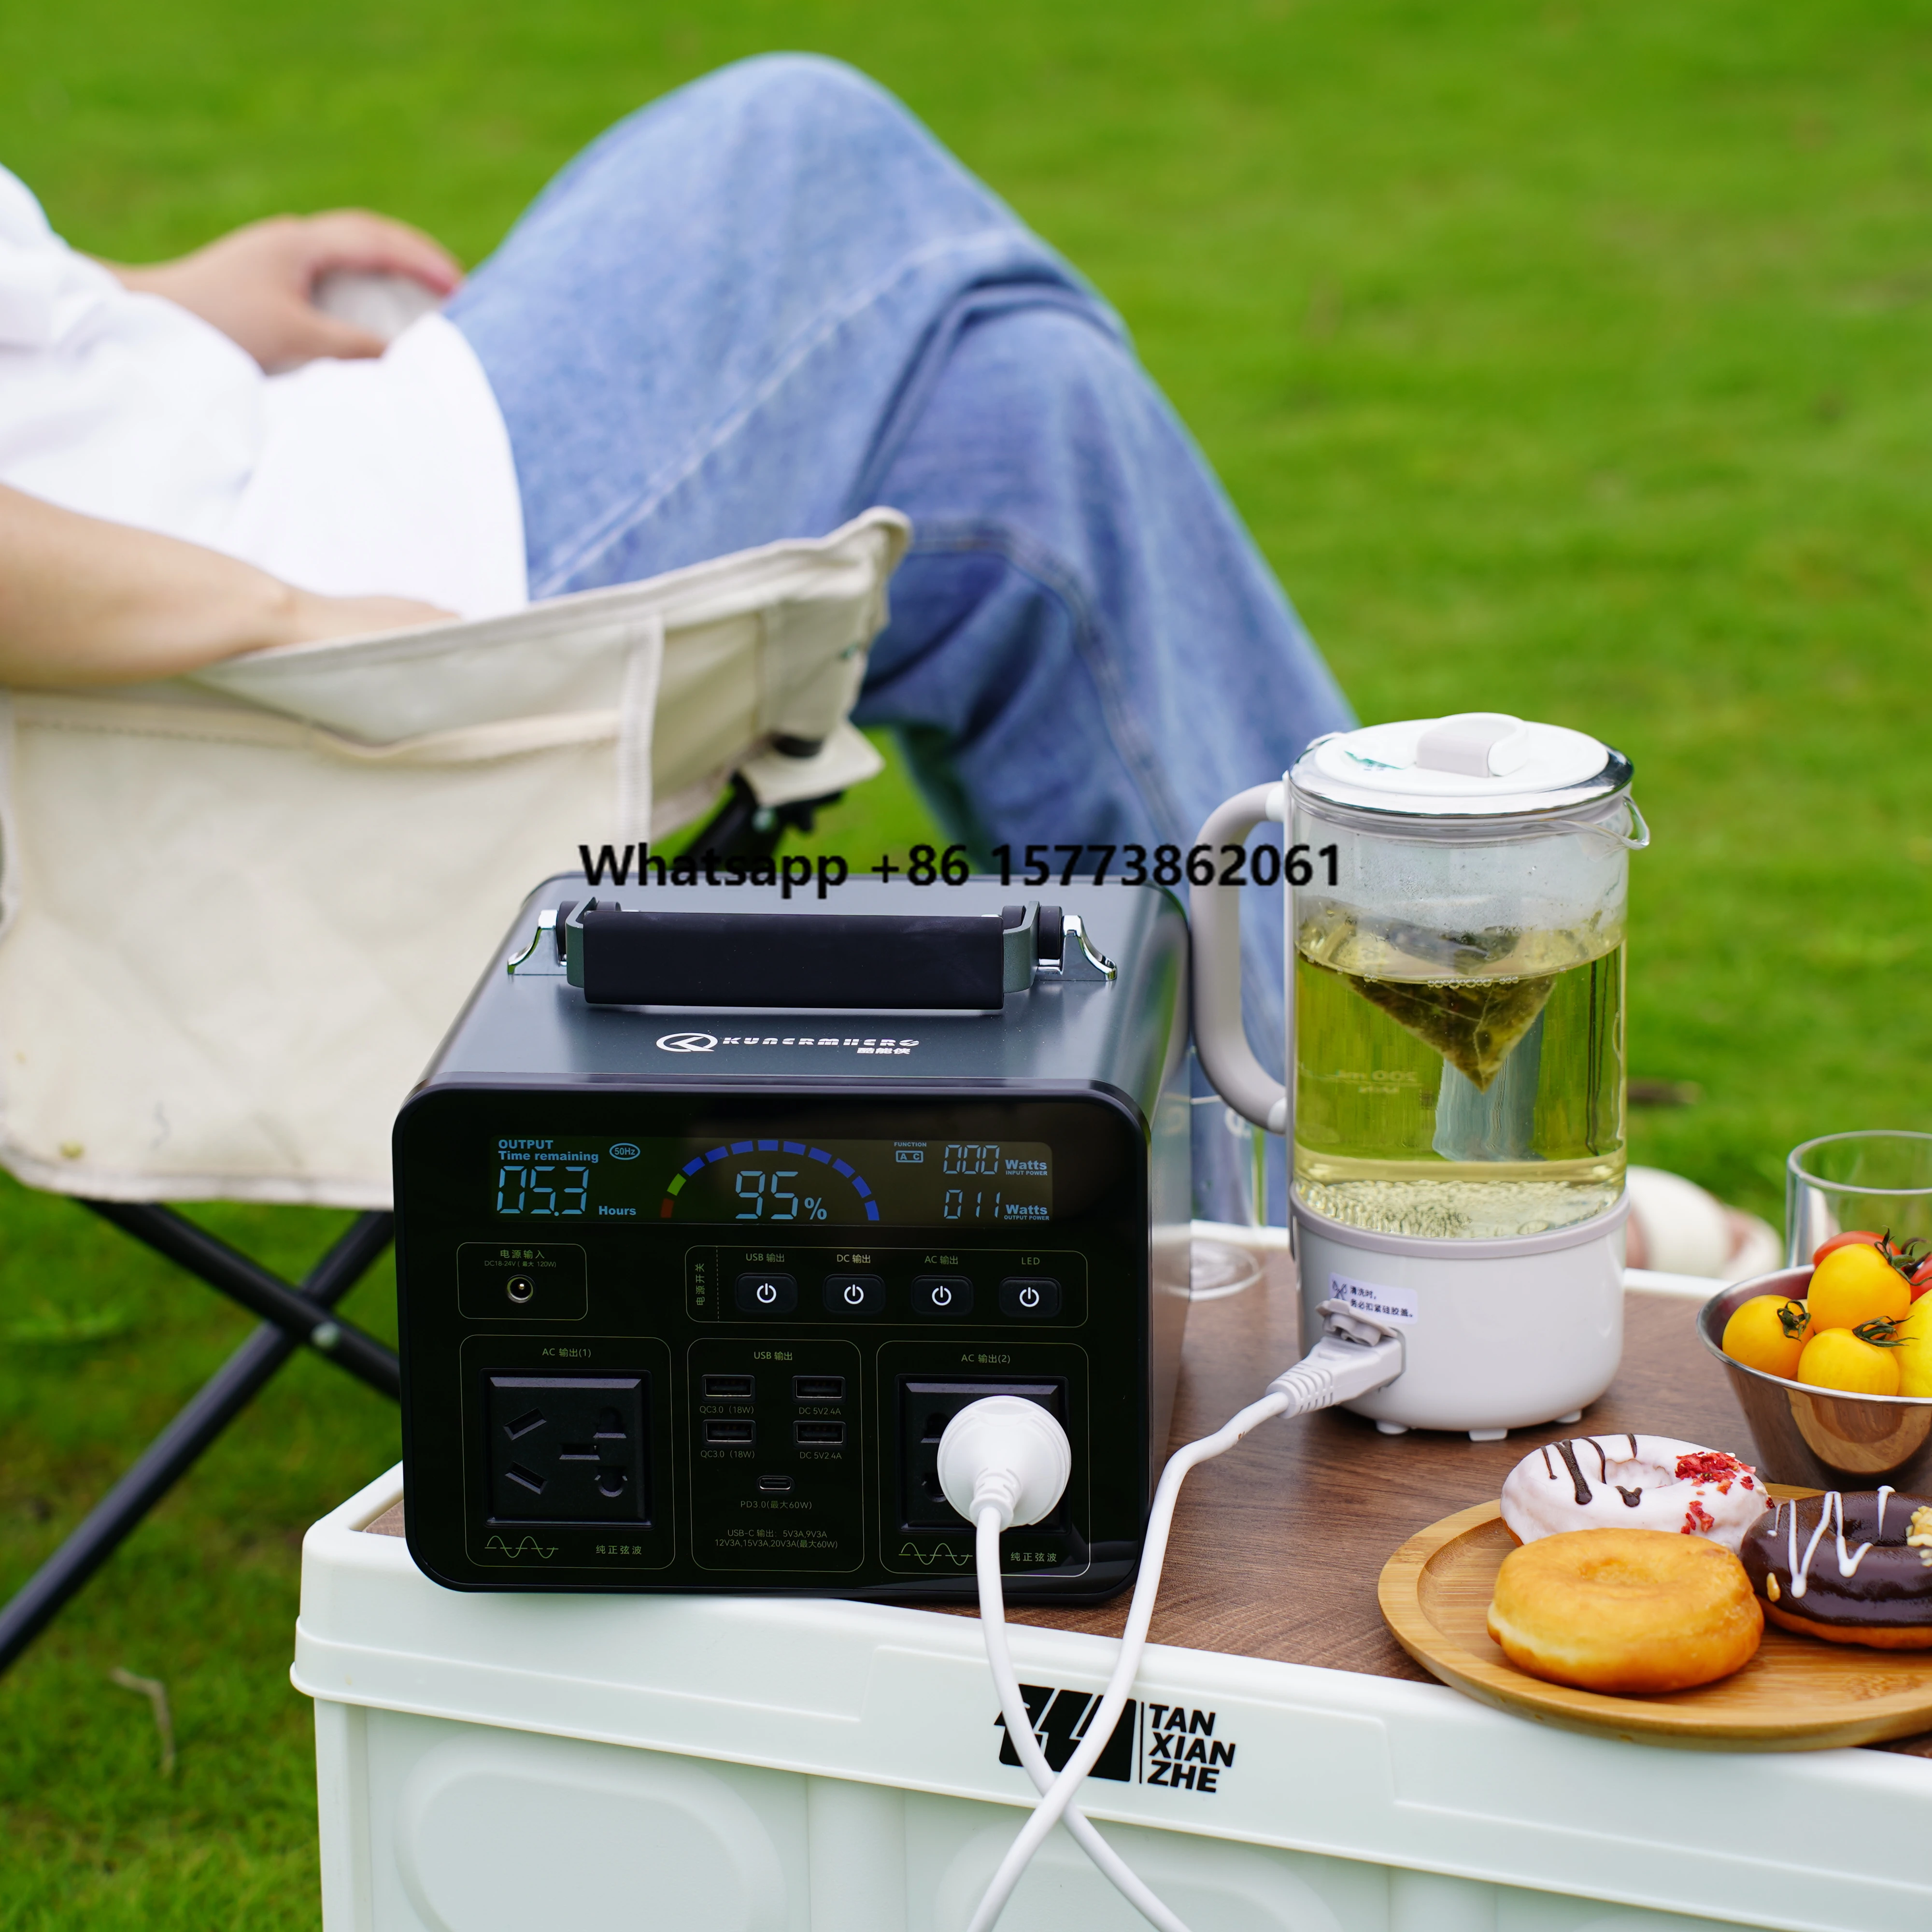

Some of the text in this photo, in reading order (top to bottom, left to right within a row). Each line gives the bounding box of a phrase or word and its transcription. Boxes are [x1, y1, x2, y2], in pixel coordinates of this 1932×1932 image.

[499, 1140, 553, 1149] OUTPUT
[614, 1147, 636, 1155] 50Hz
[498, 1151, 598, 1163] Time remaining
[943, 1145, 1047, 1174] 000 Watts
[944, 1190, 1047, 1219] 011 Watts
[599, 1206, 636, 1215] Hours
[500, 1250, 544, 1259] 电源输入
[767, 1253, 784, 1262] 输出
[852, 1254, 870, 1263] 输出
[940, 1256, 958, 1264] 输出
[695, 1264, 705, 1305] 电源开关
[559, 1348, 591, 1357] 输出(1)
[774, 1351, 792, 1360] 输出
[979, 1354, 1010, 1364] 输出(2)
[596, 1545, 641, 1554] 纯正弦波
[1011, 1552, 1056, 1562] 纯正弦波
[1150, 1705, 1215, 1735] TAN
[1149, 1733, 1235, 1766] XIAN
[1148, 1761, 1219, 1792] ZHE
